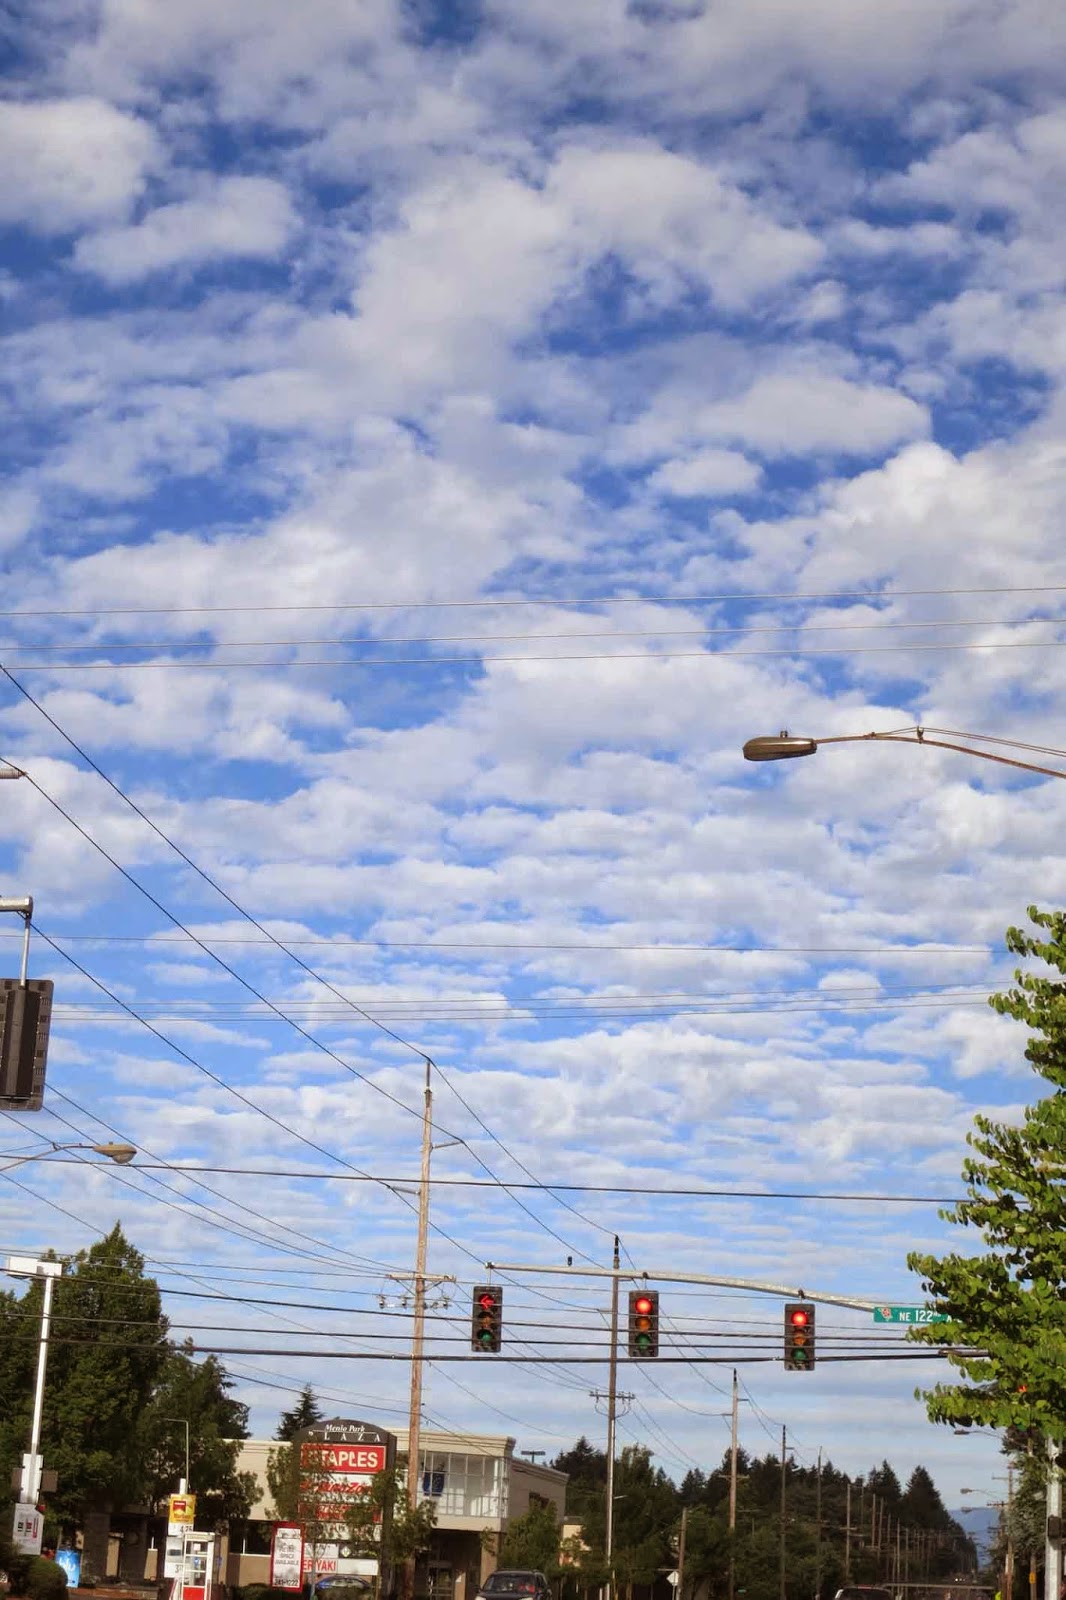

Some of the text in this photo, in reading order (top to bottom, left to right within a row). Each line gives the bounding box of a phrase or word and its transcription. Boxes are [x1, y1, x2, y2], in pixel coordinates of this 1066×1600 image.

[899, 1312, 912, 1321] NE
[325, 1424, 366, 1433] Menlo Park
